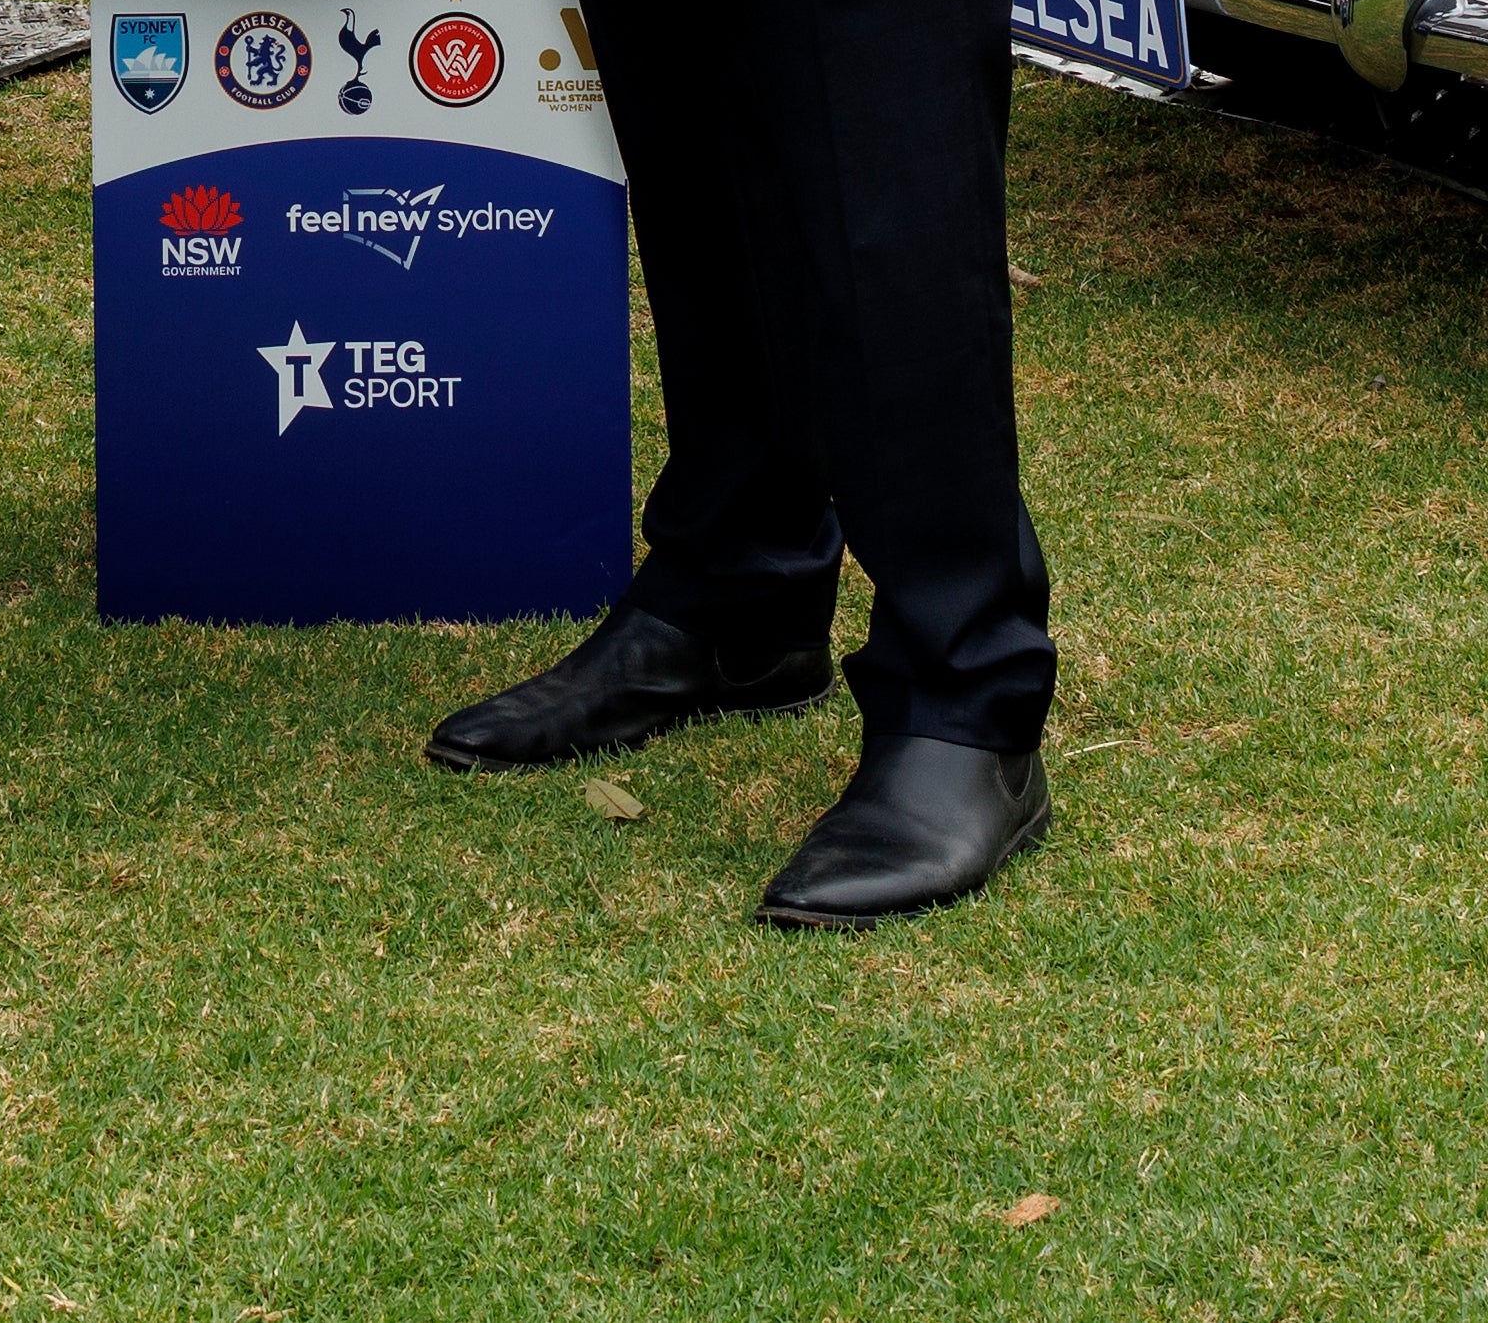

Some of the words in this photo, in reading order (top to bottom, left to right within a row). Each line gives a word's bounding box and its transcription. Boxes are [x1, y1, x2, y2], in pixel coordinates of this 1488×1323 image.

[120, 20, 178, 35] SYDNEY
[231, 15, 294, 37] CHELSEA
[429, 24, 458, 41] WESTERN
[459, 24, 484, 41] SYDNEY
[143, 35, 157, 45] FC
[436, 84, 479, 96] WANDERERS
[537, 79, 603, 92] LEAGUES
[231, 87, 272, 105] FOOTBALL
[275, 86, 296, 102] CLUB
[538, 94, 559, 103] ALL
[568, 94, 603, 102] STARS
[549, 103, 592, 112] WOMEN
[285, 203, 350, 233] feel
[357, 208, 430, 232] new
[436, 201, 554, 238] sydney
[161, 237, 242, 265] NSW
[161, 266, 242, 276] GOVERNMENT
[344, 340, 426, 373] TEG
[343, 376, 462, 409] SPORT
